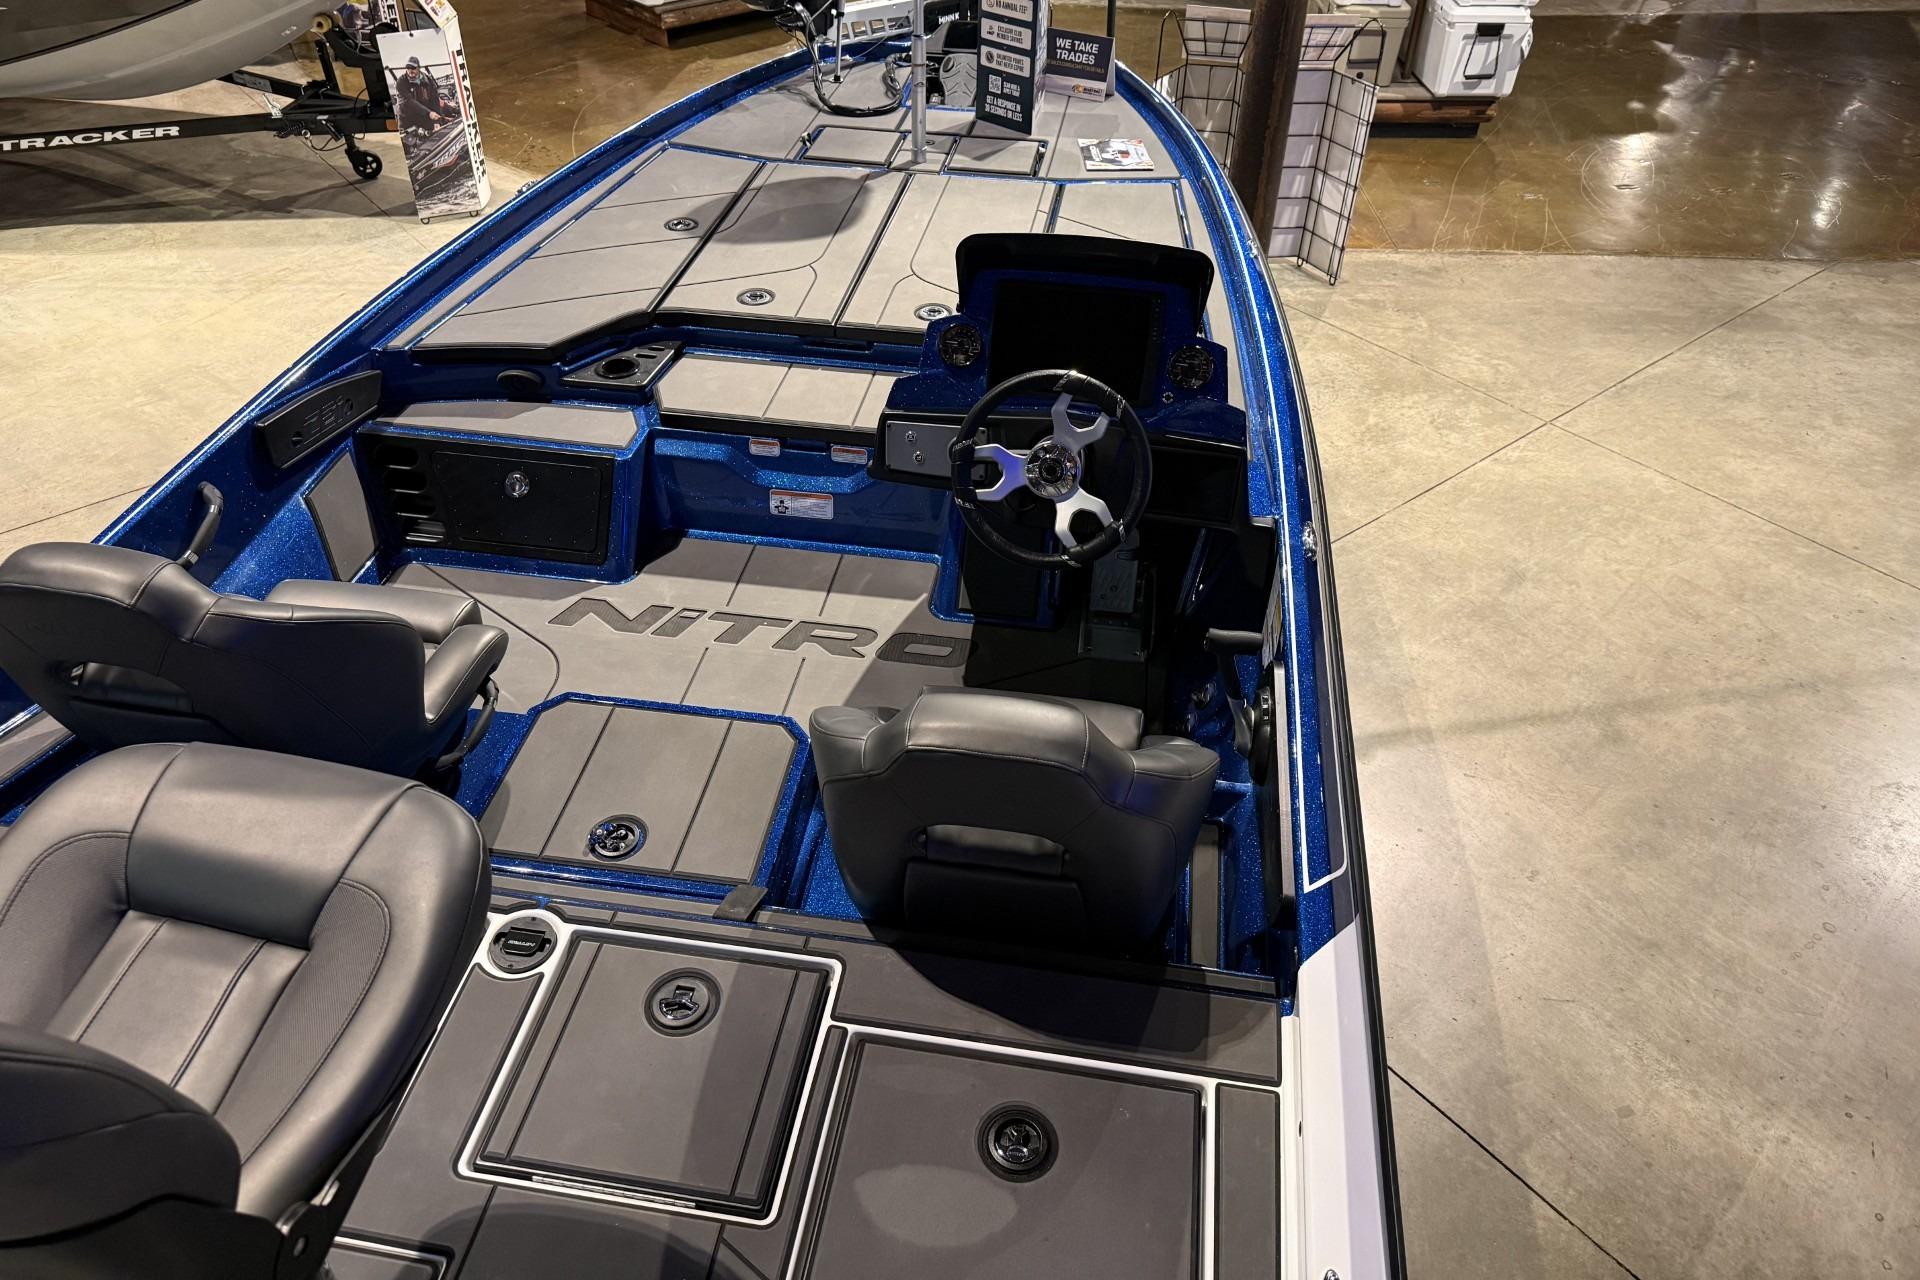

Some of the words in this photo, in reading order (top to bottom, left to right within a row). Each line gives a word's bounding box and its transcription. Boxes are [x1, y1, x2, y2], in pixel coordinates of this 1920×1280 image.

[1002, 1, 1018, 12] ANNUAL
[1056, 37, 1072, 49] WE
[1074, 40, 1099, 54] TAKE
[1056, 49, 1095, 65] TRADES
[456, 42, 486, 177] TRACKER
[990, 104, 1006, 117] SECONDS
[1007, 110, 1012, 119] OR
[998, 98, 1016, 111] RESPONSE
[0, 126, 180, 151] TRACKER
